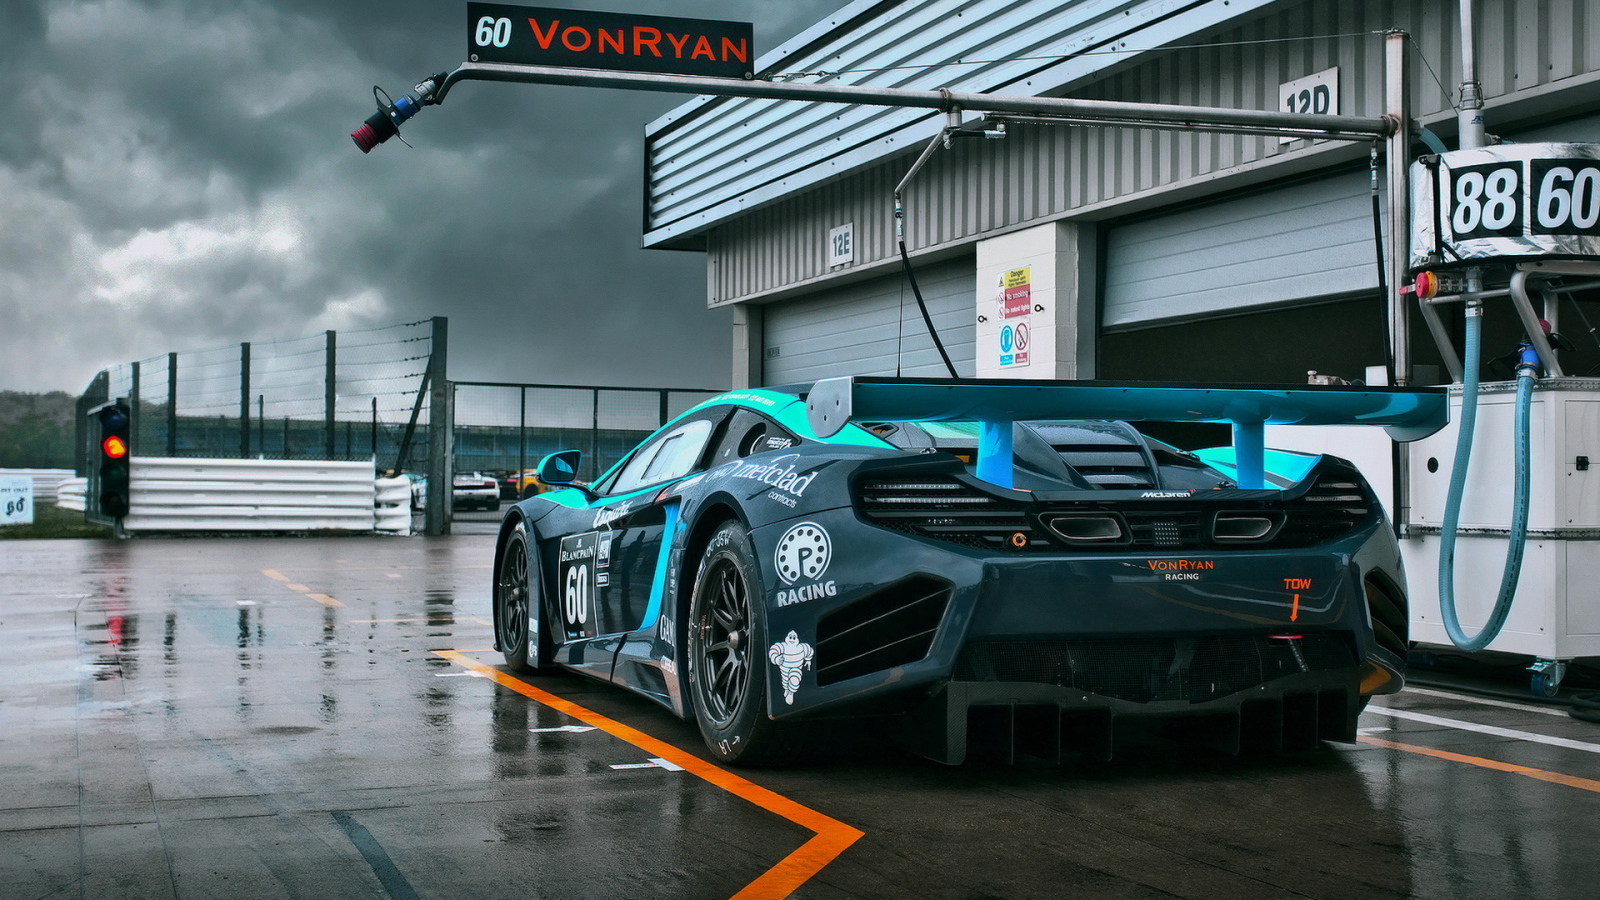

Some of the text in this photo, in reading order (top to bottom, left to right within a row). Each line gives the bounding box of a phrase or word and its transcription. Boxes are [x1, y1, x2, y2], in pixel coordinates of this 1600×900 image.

[475, 16, 512, 48] 60
[1286, 84, 1330, 115] 12D
[1453, 167, 1518, 234] 88
[1537, 166, 1600, 229] 60
[833, 232, 850, 257] 12E
[1013, 290, 1029, 299] smoking
[767, 491, 797, 508] contracts
[561, 545, 595, 562] BLANCPAIN
[1165, 573, 1200, 581] RACING
[1283, 578, 1312, 590] TOW
[566, 564, 588, 625] 60
[776, 579, 837, 608] RACING
